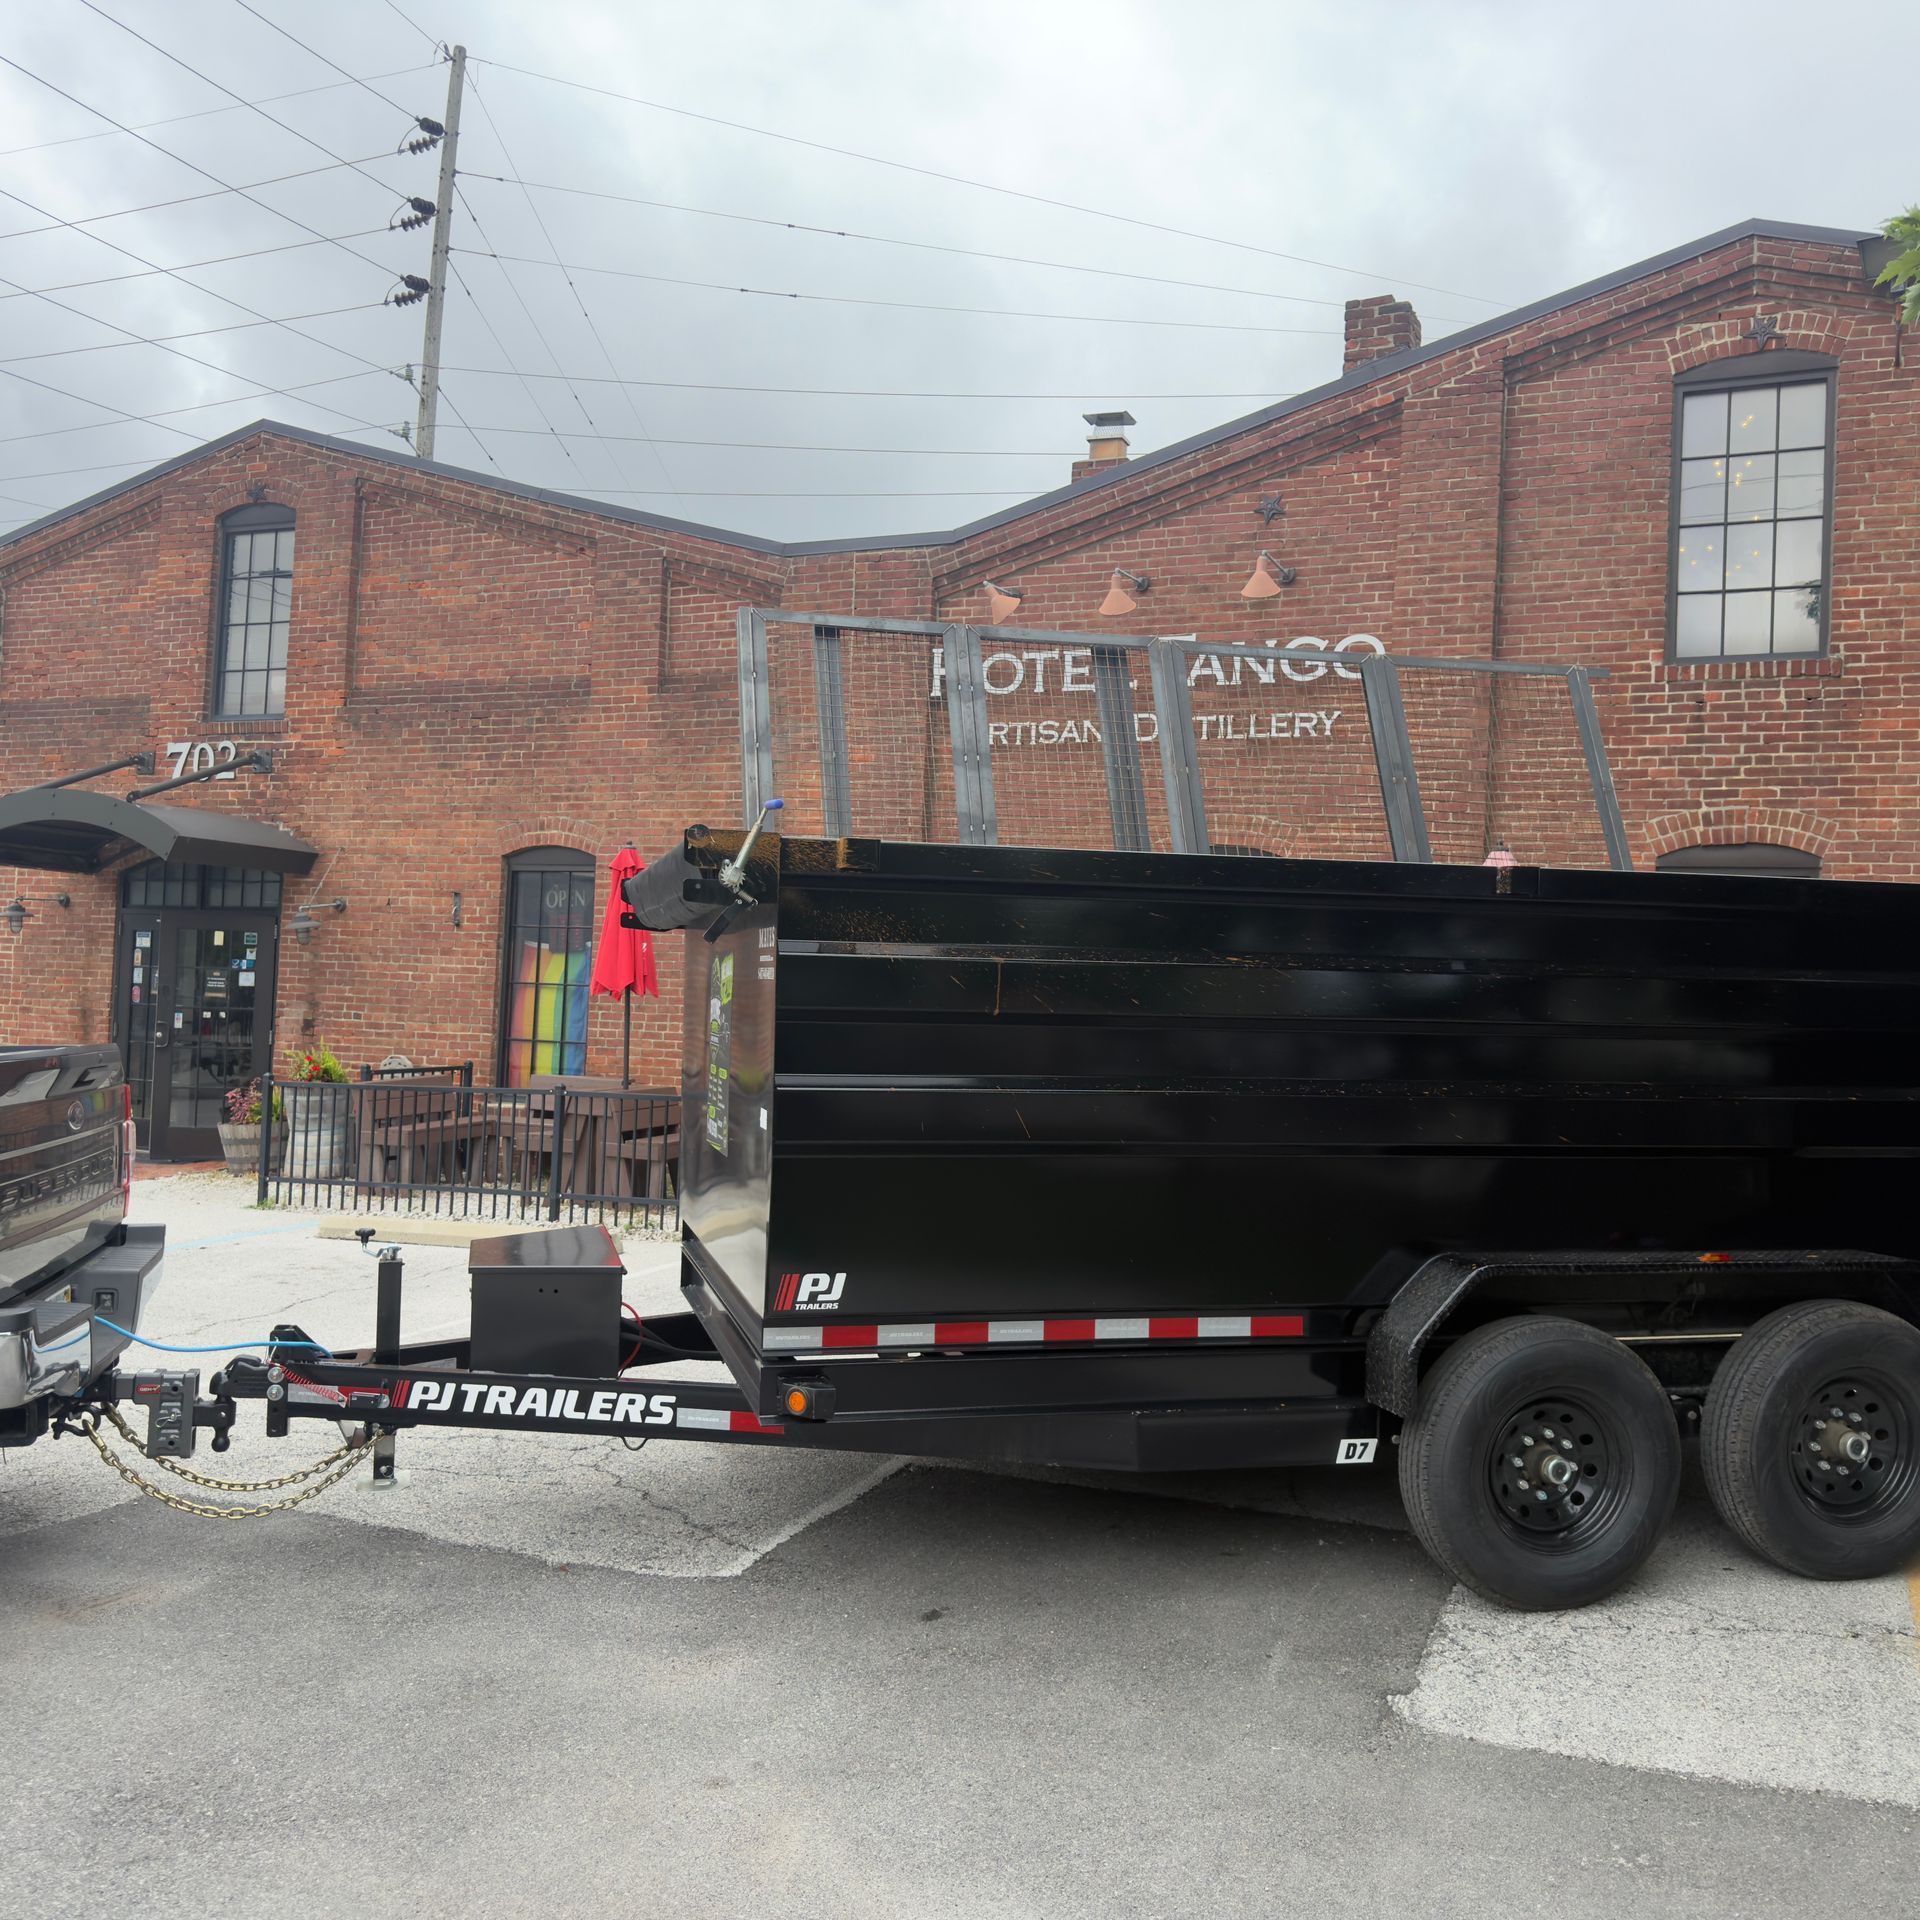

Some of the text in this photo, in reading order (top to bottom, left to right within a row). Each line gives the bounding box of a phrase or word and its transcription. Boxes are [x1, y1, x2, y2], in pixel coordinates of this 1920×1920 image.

[930, 647, 1138, 697] HOTE
[987, 710, 1342, 746] RTISAN DTILLERY
[166, 740, 236, 781] 702
[546, 889, 586, 909] OPN
[797, 1272, 847, 1302] PJ
[795, 1302, 839, 1311] TRAILERS
[407, 1380, 677, 1425] PJ TRAILERS
[1344, 1442, 1370, 1460] D7
